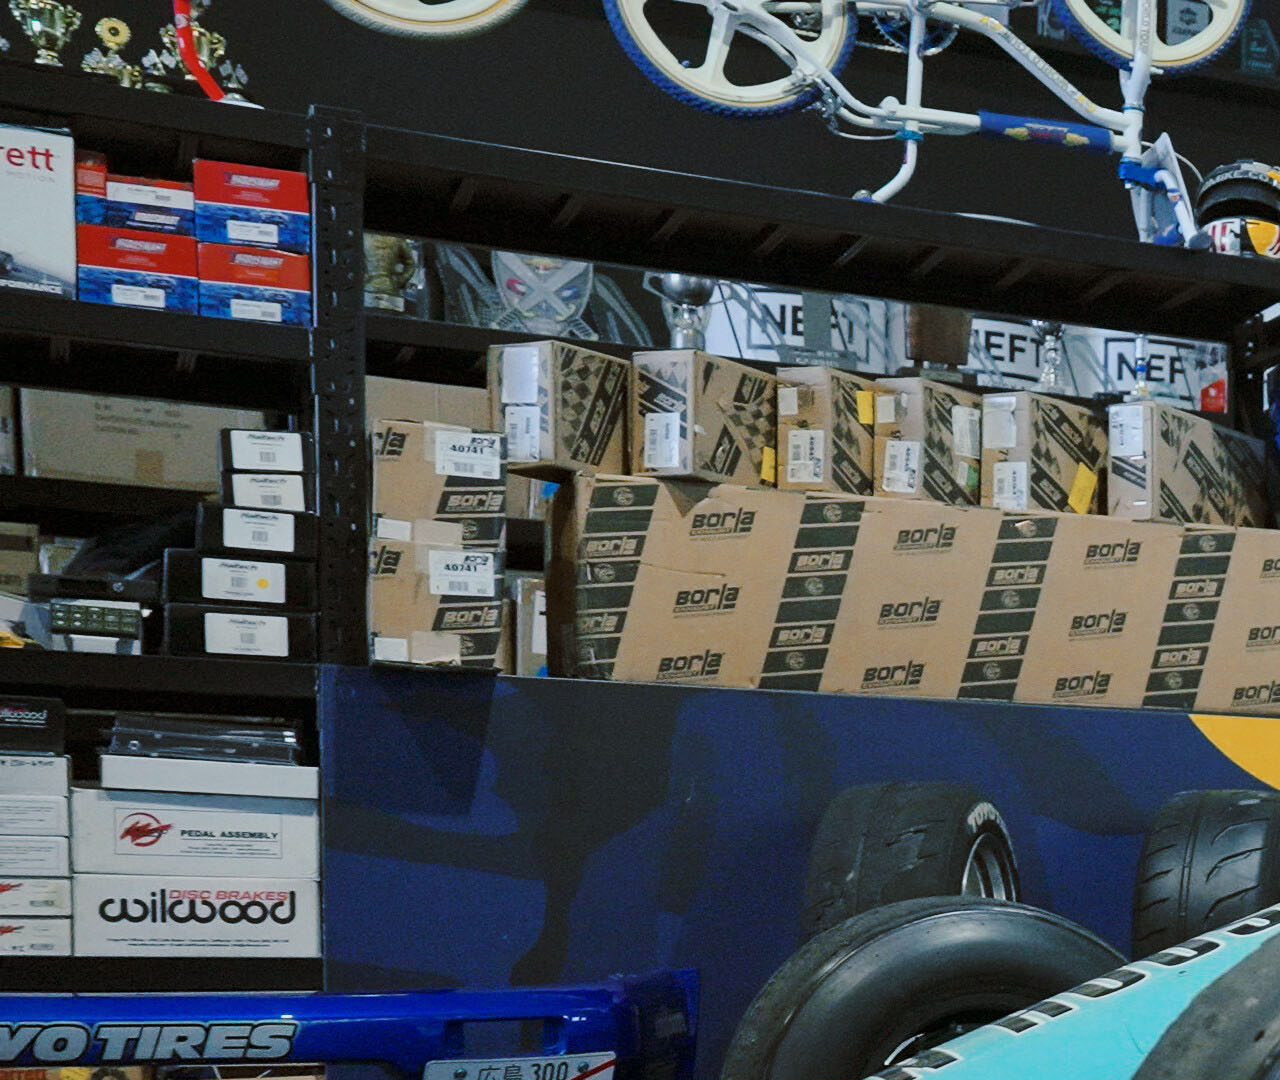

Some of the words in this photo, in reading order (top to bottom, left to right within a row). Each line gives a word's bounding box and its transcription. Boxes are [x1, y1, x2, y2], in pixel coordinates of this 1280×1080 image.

[0, 145, 55, 172] ett
[180, 829, 214, 839] PEDAL
[220, 830, 279, 841] ASSEMBLY
[99, 888, 296, 925] wilwood
[169, 889, 211, 901] DISC
[215, 890, 289, 902] BRAKES
[100, 1022, 298, 1062] TIRES
